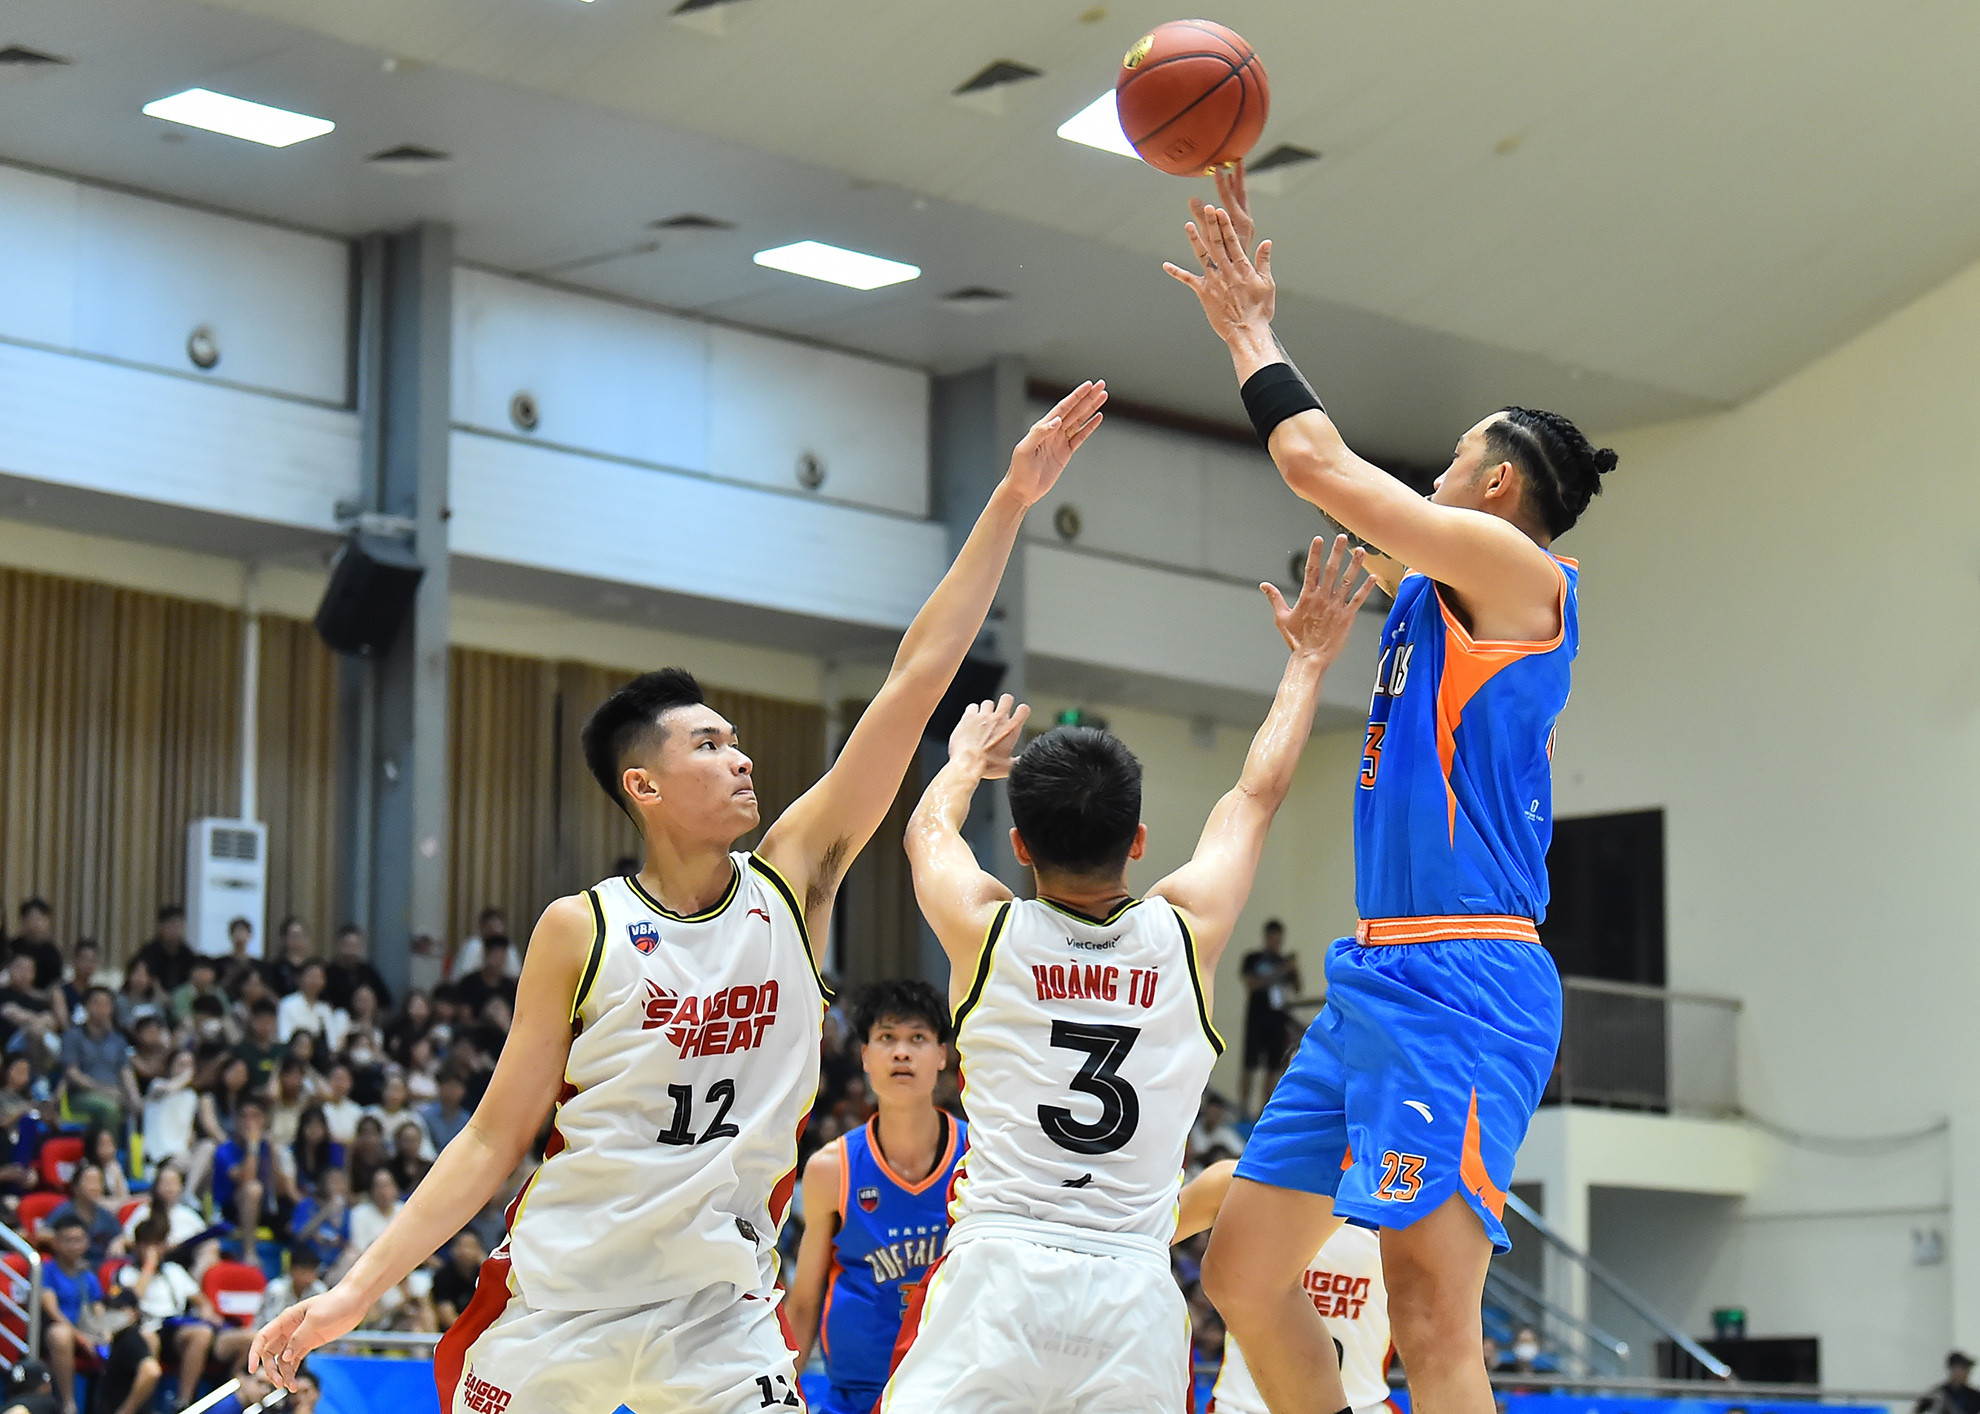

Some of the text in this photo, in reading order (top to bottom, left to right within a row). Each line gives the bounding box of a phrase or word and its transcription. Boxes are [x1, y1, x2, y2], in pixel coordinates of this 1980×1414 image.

[631, 924, 656, 936] VBA
[1066, 937, 1116, 950] VietCredit
[642, 979, 779, 1030] SAIGON
[1031, 958, 1159, 1009] HOÀNG TÚ
[667, 1014, 776, 1060] HEAT
[1037, 1019, 1141, 1155] 3
[656, 1078, 740, 1145] 12
[1370, 1150, 1427, 1204] 23
[1302, 1269, 1372, 1299] IGON
[1308, 1293, 1367, 1321] EAT
[463, 1372, 513, 1407] SAIGON
